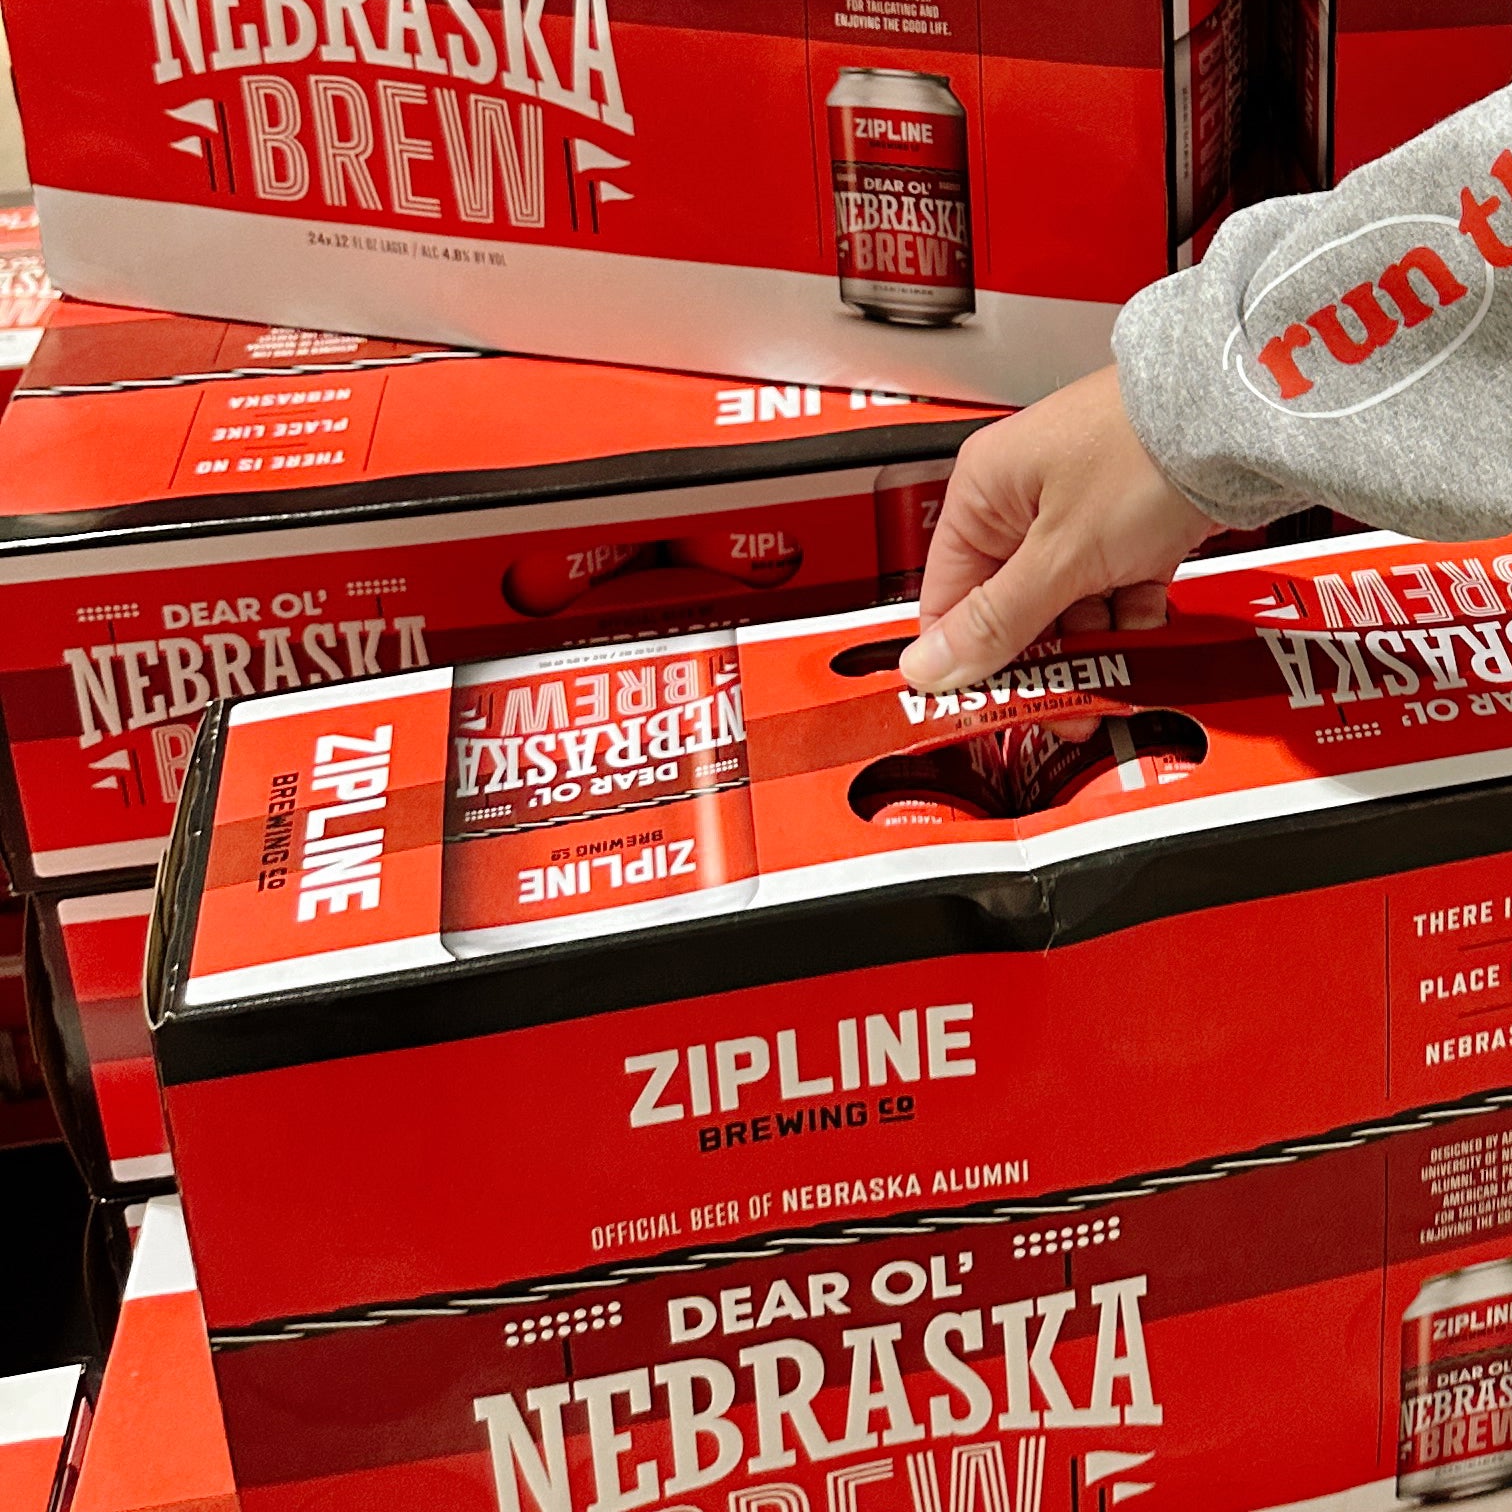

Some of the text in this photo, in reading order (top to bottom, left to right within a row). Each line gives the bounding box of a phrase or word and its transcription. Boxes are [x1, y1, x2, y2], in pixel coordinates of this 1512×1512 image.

[240, 73, 546, 230] BREW
[854, 116, 934, 146] ZIPLINE
[863, 175, 903, 194] DEAR
[834, 190, 968, 243] NEBRASKA
[854, 232, 950, 278] BREW
[1258, 246, 1469, 400] run
[227, 388, 352, 409] NEBRASKA
[161, 587, 329, 631] DEAR OL'
[502, 661, 701, 739] BREW
[898, 653, 1131, 725] NEBRASKA
[1402, 693, 1462, 727] OL'
[455, 683, 748, 800] NEBRASKA
[528, 759, 680, 810] DEAR OL'
[259, 771, 299, 873] BREWING
[298, 723, 394, 923] ZIPLINE
[575, 828, 665, 859] BREWING
[518, 838, 698, 905] ZIPLINE
[1413, 905, 1495, 938] THERE
[1419, 966, 1500, 1003] PLACE
[624, 1002, 977, 1129] ZIPLINE
[698, 1100, 869, 1154] BREWING
[1430, 1136, 1483, 1164] DESIGNED
[1421, 1153, 1482, 1183] UNIVERSITY
[1479, 1165, 1499, 1183] THE
[590, 1159, 1032, 1252] OFFICIAL BEER OF NEBRASKA ALUMNI
[1442, 1182, 1499, 1209] AMERICAN
[1419, 1219, 1474, 1245] ENJOYING
[667, 1250, 975, 1347] DEAR OL'
[472, 1273, 1164, 1512] NEBRASKA
[1436, 1365, 1487, 1390] DEAR
